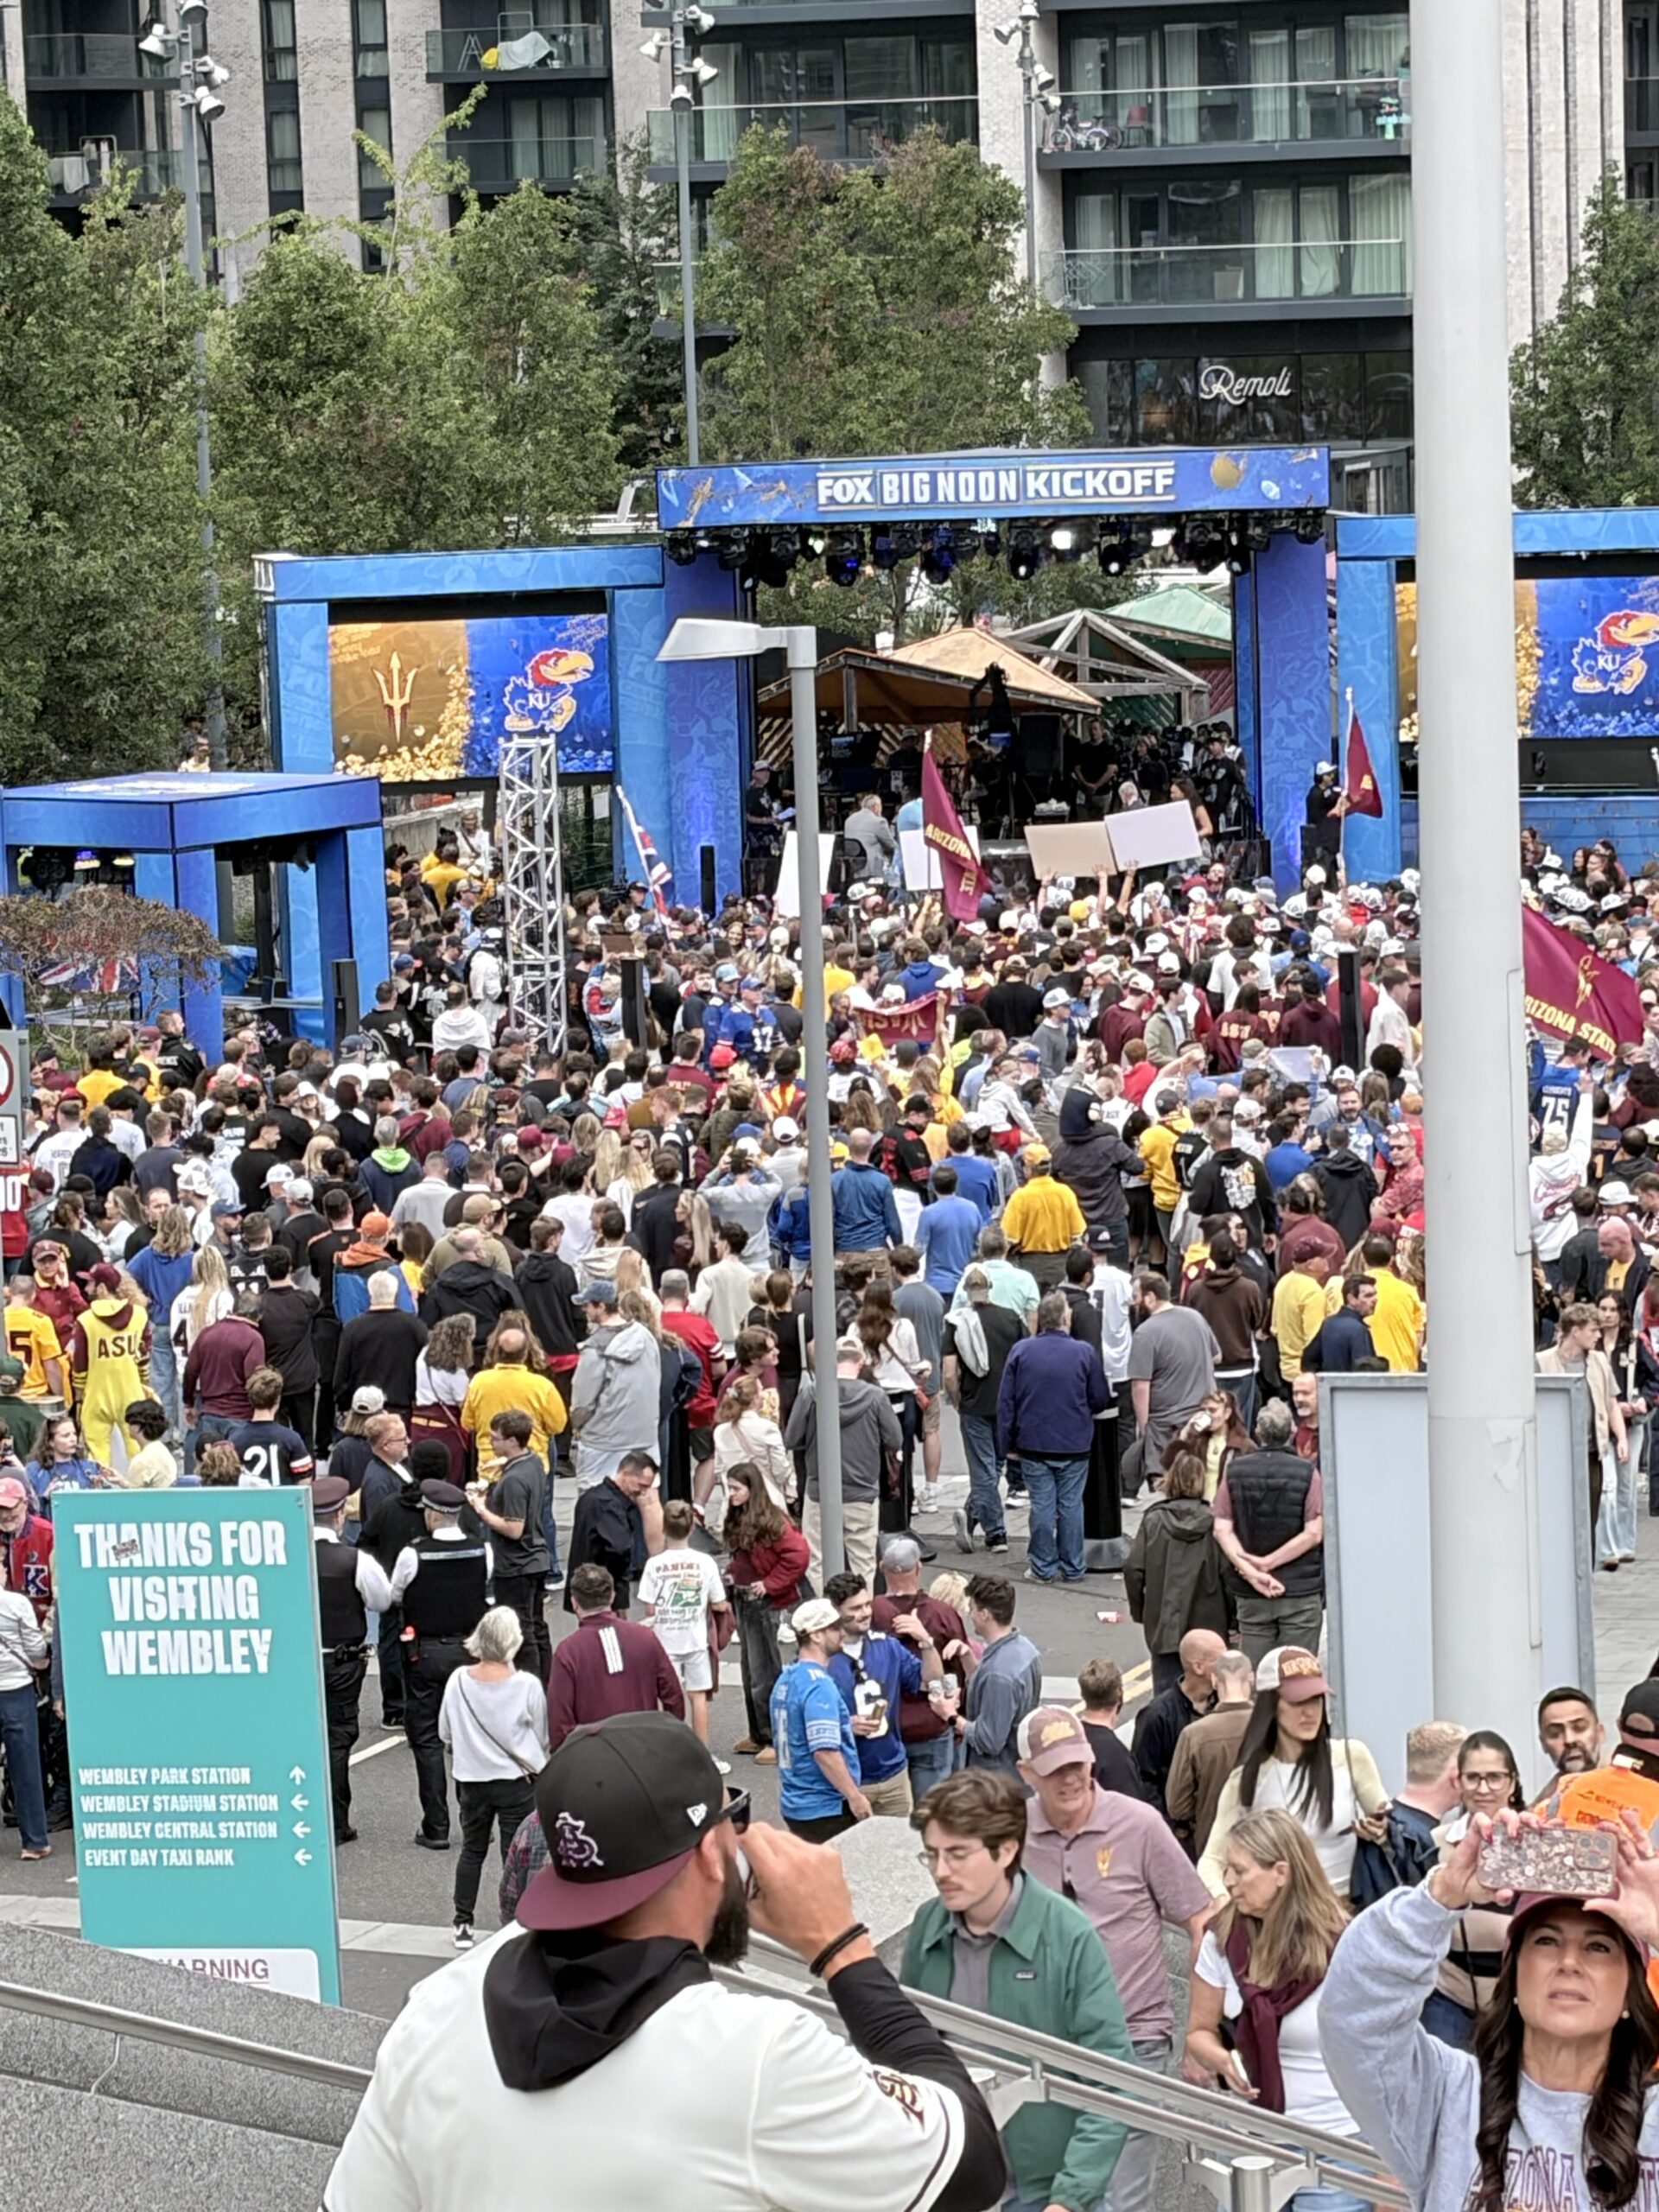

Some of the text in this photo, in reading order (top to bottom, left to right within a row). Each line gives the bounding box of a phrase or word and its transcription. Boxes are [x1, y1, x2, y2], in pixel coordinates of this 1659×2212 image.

[1199, 365, 1291, 405] Remoli
[817, 467, 1176, 505] FOX BIG NOON KICKOFF
[1596, 653, 1621, 672] KU
[528, 690, 550, 710] KU
[925, 823, 973, 861] ARIZONA
[73, 1521, 213, 1568] THANKS
[220, 1520, 287, 1567] FOR
[108, 1574, 259, 1621] VISITING
[100, 1628, 272, 1675] WEMBLEY
[79, 1767, 251, 1785] WEMBLEY PARK STATION
[80, 1794, 279, 1813] WEMBLEY STADIUM STATION
[83, 1821, 278, 1840] WEMBLEY CENTRAL STATION
[85, 1848, 235, 1866] EVENT DAY TAXI RANK
